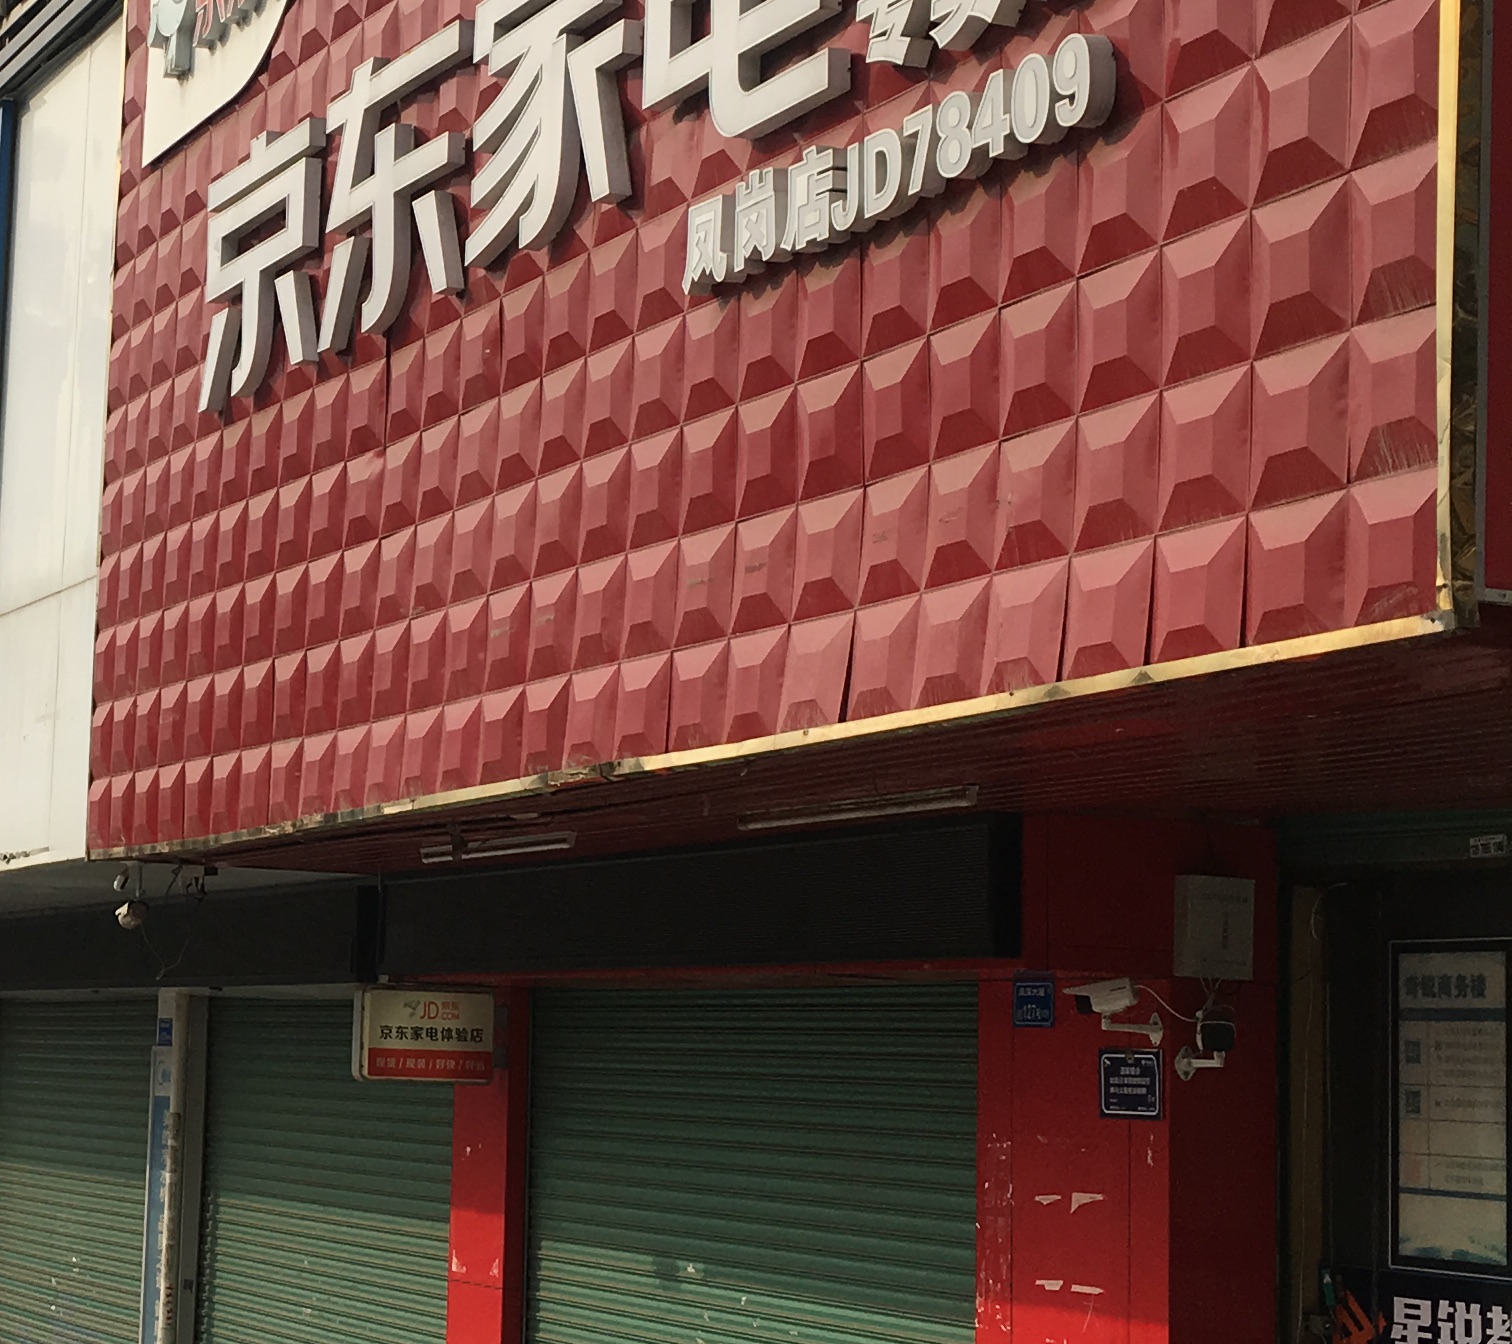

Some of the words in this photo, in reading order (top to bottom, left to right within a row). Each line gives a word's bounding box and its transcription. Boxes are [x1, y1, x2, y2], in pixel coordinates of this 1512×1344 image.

[684, 34, 1117, 297] 凤岗店JD78409
[419, 1000, 439, 1020] JD
[379, 1024, 484, 1043] 京东家电体验店
